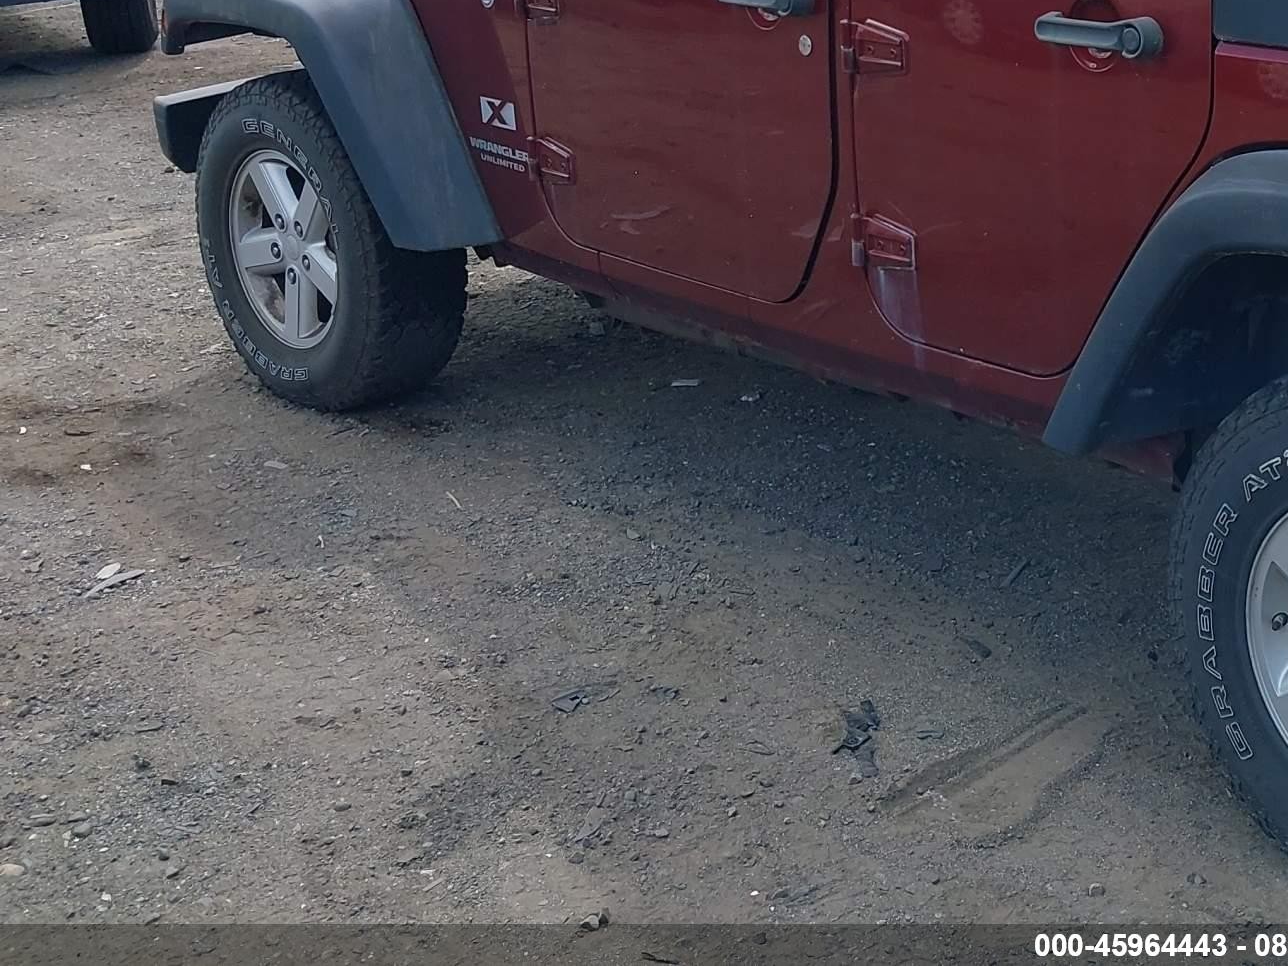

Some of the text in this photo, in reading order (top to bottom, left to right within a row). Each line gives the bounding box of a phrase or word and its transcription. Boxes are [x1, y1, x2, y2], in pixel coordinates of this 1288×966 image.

[241, 118, 340, 234] GENERAL
[469, 136, 528, 162] WRANGLER
[480, 152, 526, 172] UNLIMITED
[1197, 502, 1253, 760] GRABBER
